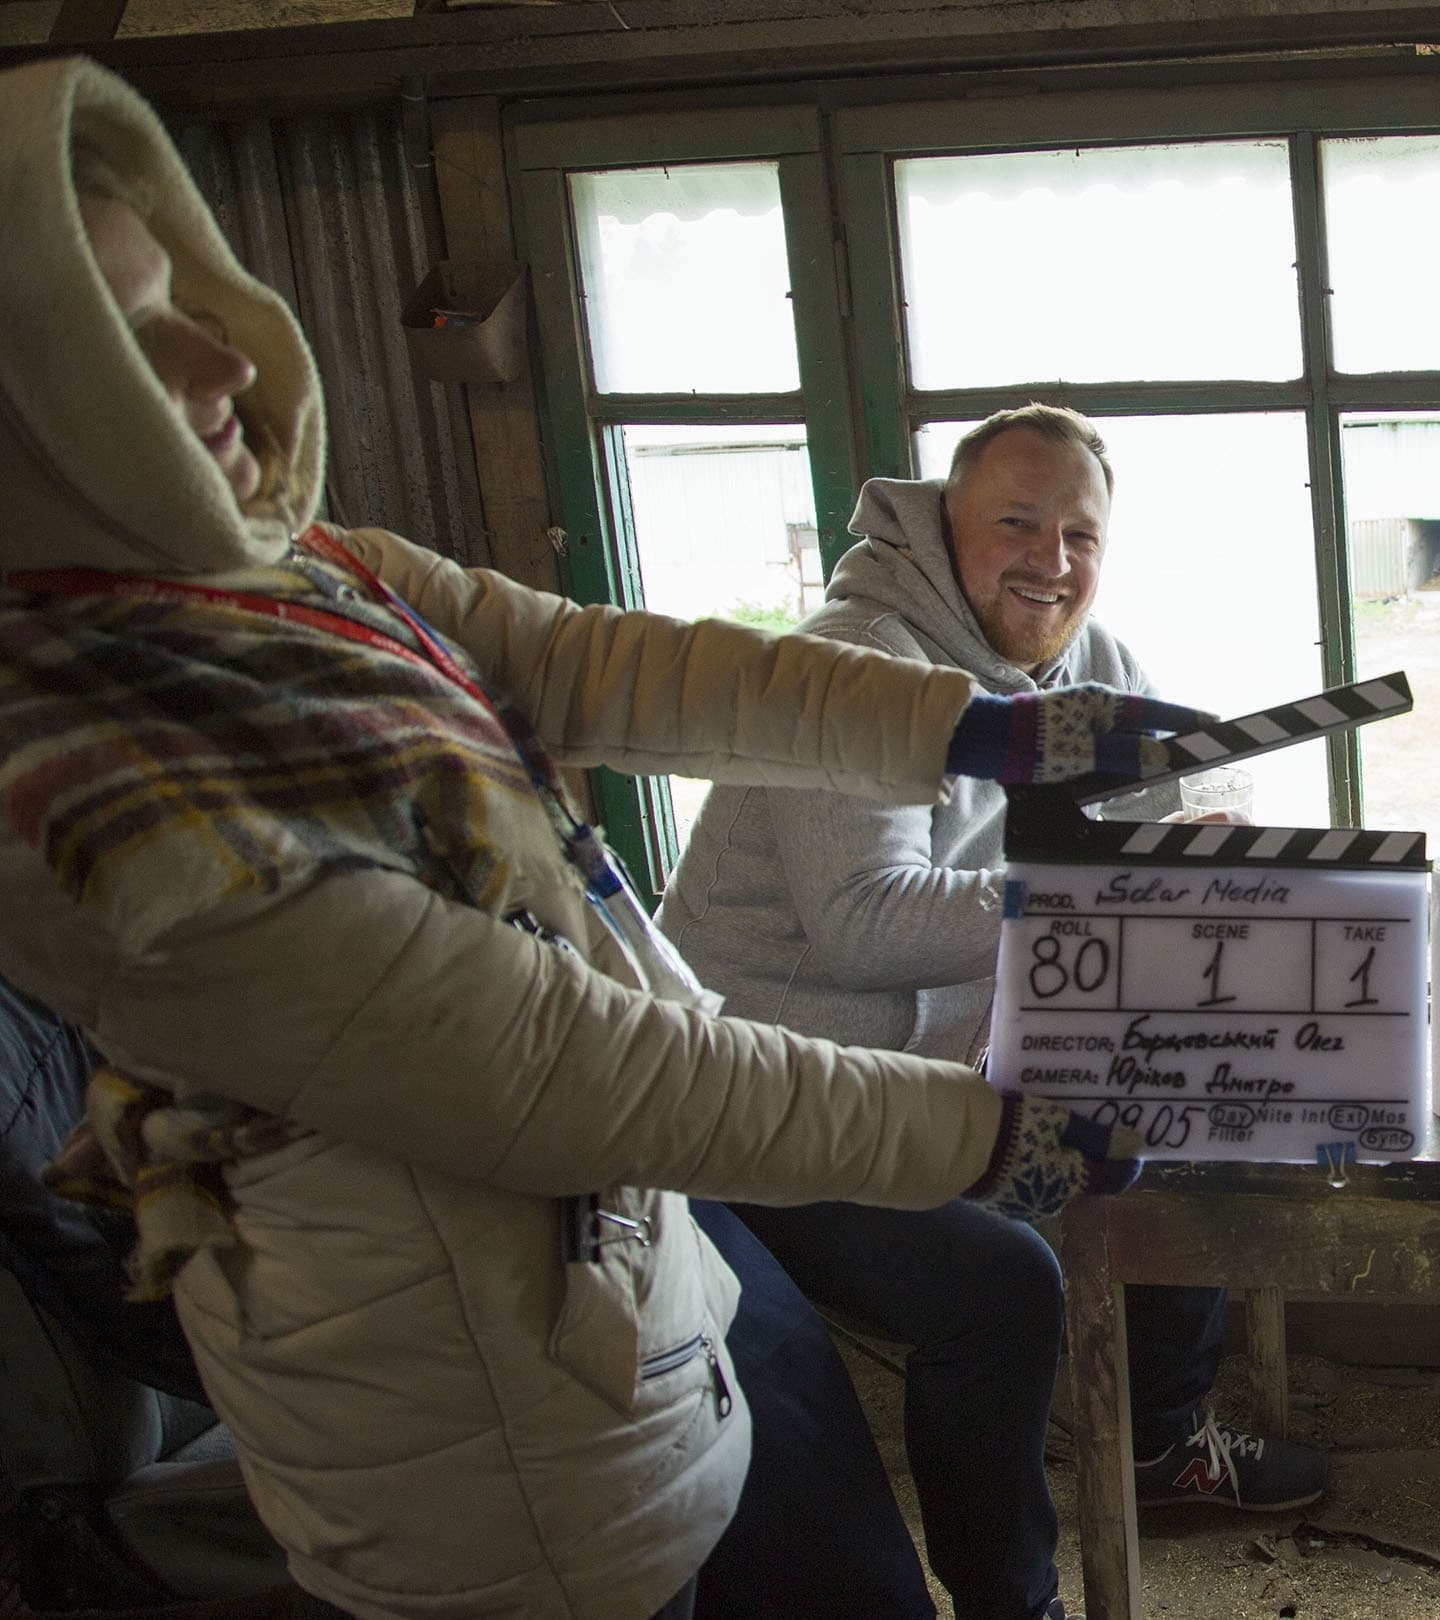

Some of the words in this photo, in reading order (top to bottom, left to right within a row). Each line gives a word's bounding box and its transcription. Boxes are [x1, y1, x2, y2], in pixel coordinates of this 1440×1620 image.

[1096, 872, 1190, 905] Solar
[1202, 876, 1291, 905] Media
[1027, 893, 1075, 909] PROD.
[1050, 920, 1093, 936] ROLL
[1191, 924, 1249, 940] SCENE
[1344, 926, 1386, 942] TAKE
[1029, 935, 1110, 999] 80
[1197, 941, 1236, 1007] 1
[1344, 946, 1380, 1008] 1
[1021, 1036, 1114, 1052] DIRECTOR:
[1020, 1067, 1099, 1085] CAMERA:
[1213, 1109, 1248, 1127] Day
[1256, 1109, 1293, 1124] Nite
[1302, 1109, 1326, 1124] Int
[1334, 1109, 1364, 1124] Ext
[1370, 1110, 1407, 1125] Mos
[1208, 1127, 1254, 1143] Filter
[1366, 1130, 1411, 1146] Sync
